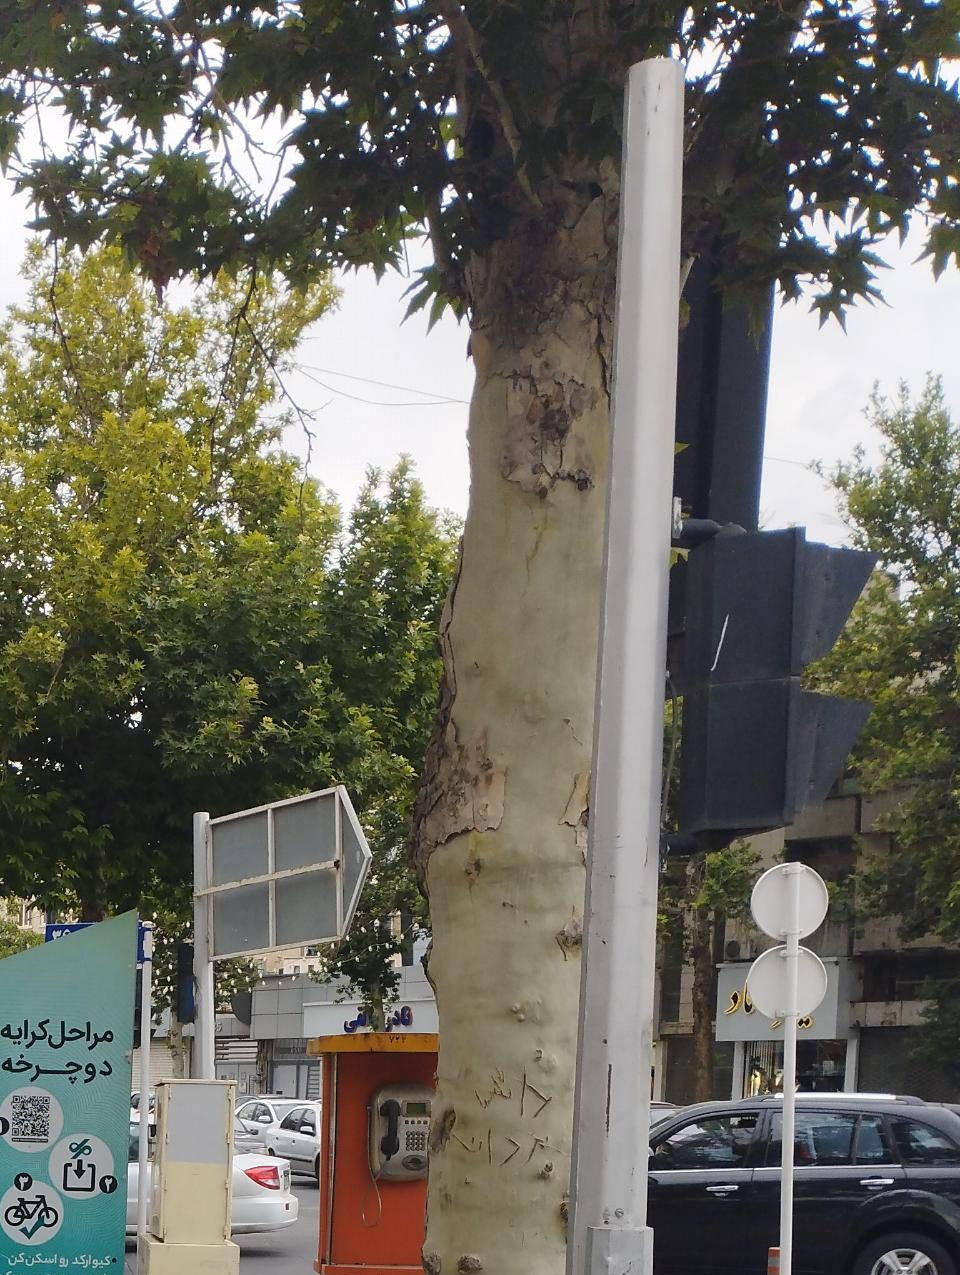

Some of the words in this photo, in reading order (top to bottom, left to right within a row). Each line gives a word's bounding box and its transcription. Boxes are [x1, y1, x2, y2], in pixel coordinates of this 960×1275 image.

[0, 1019, 50, 1049] کرایه
[48, 1021, 114, 1051] مراحل
[1, 1053, 113, 1084] دوچرخه
[7, 1252, 25, 1266] کن
[25, 1253, 57, 1266] اسکن
[58, 1258, 69, 1268] رو
